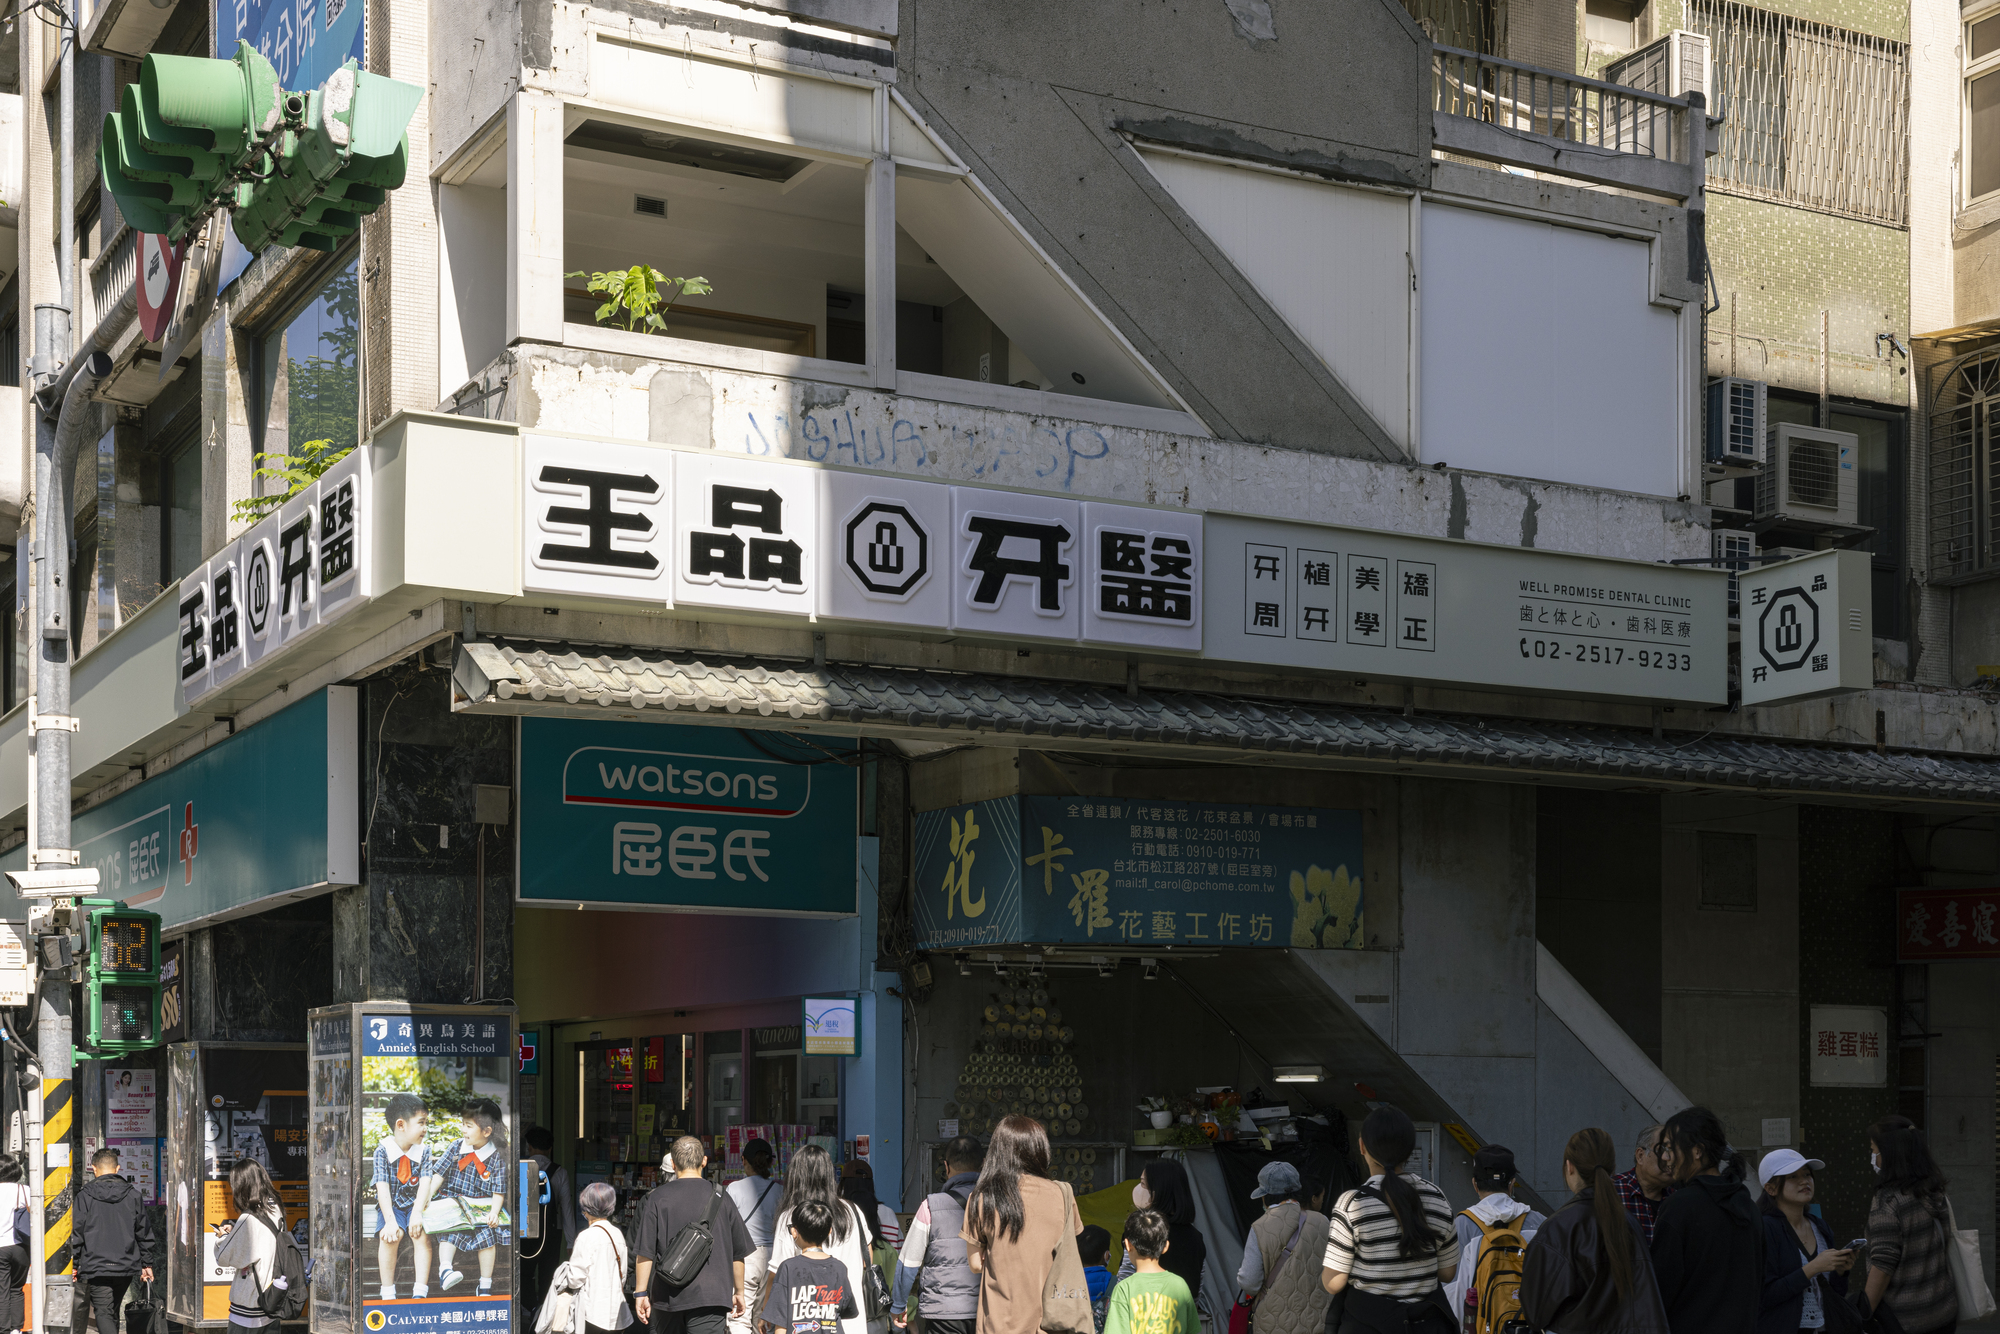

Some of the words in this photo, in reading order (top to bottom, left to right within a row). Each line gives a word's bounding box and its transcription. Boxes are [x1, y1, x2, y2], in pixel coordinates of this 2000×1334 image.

[539, 465, 804, 586] 王品
[1253, 554, 1280, 628] 牙周
[1303, 560, 1331, 633] 植牙
[1354, 566, 1381, 637] 美學
[1403, 571, 1429, 642] 矯正
[1519, 580, 1549, 594] WELL
[1554, 584, 1604, 599] PROMISE
[1609, 591, 1650, 604] DENTAL
[1654, 595, 1691, 608] CLINIC
[180, 567, 239, 681] 王品
[1534, 640, 1691, 671] 02-2517-9233
[599, 761, 779, 800] watsons
[129, 830, 160, 886] 屈臣氏
[612, 821, 771, 882] 屈臣氏
[941, 808, 986, 920] 花
[1118, 909, 1273, 942] 花藝工作坊
[378, 1042, 416, 1053] Annie's
[420, 1042, 457, 1055] English
[461, 1042, 496, 1053] School
[398, 1022, 496, 1038] 奇異鳥美語
[1817, 1030, 1879, 1058] 雞蛋糕
[441, 1309, 508, 1324] 美國小學課程
[791, 1285, 817, 1305] LAP
